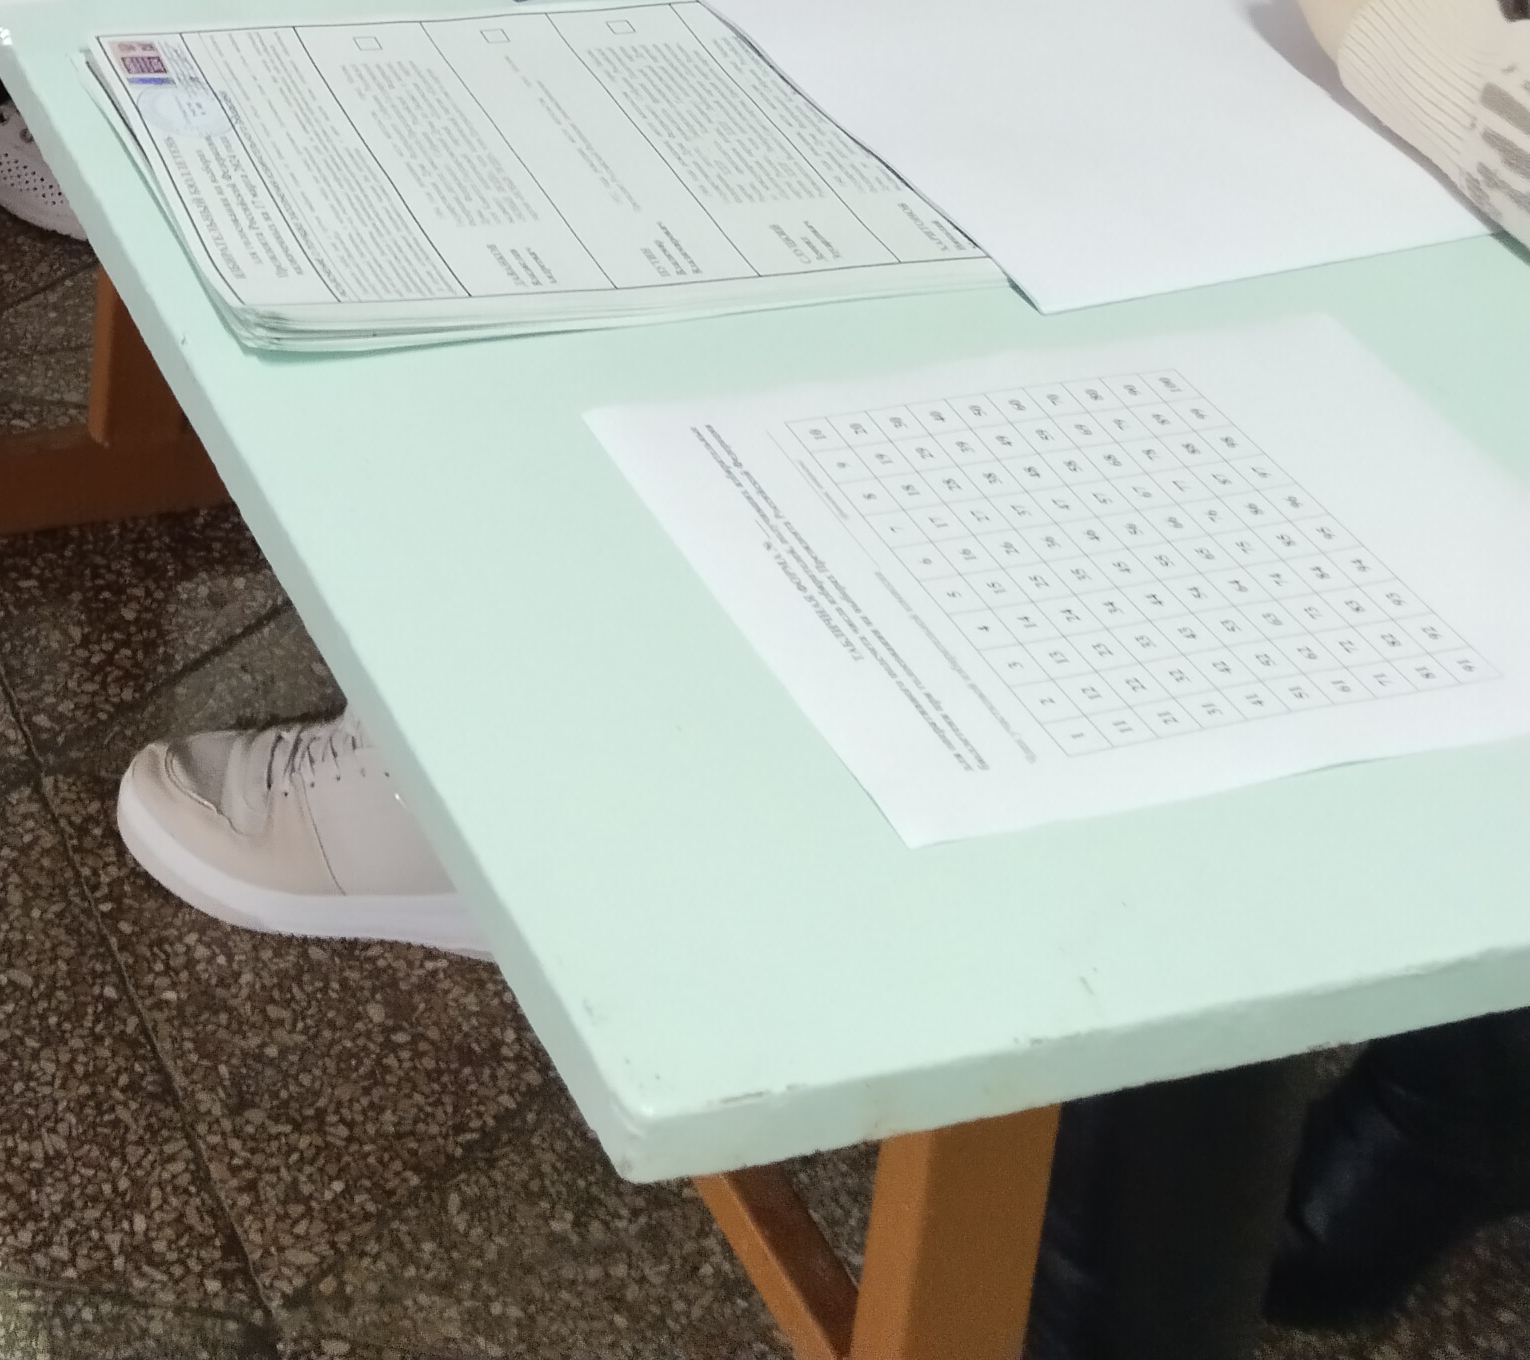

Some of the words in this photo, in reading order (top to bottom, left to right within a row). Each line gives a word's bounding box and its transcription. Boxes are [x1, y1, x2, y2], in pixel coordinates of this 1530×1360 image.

[1035, 428, 1055, 441] 59
[1074, 423, 1093, 436] 69
[954, 440, 975, 454] 39
[995, 435, 1013, 447] 49
[874, 452, 894, 466] 19
[914, 447, 935, 460] 29
[1102, 453, 1123, 467] 68
[1022, 465, 1041, 479] 48
[1062, 459, 1083, 473] 58
[941, 477, 963, 492] 28
[982, 472, 1003, 485] 38
[900, 483, 921, 497] 18
[1131, 485, 1153, 499] 67
[1171, 480, 1187, 493] 77
[1050, 498, 1071, 511] 47
[1091, 492, 1114, 505] 57
[969, 510, 991, 523] 27
[1009, 504, 1032, 517] 37
[1204, 509, 1218, 523] 76
[927, 516, 949, 529] 17
[1124, 522, 1144, 536] 56
[1164, 516, 1184, 529] 66
[1041, 535, 1062, 549] 36
[1083, 529, 1101, 542] 46
[958, 548, 978, 561] 16
[1000, 541, 1021, 556] 26
[1193, 547, 1216, 561] 65
[1234, 540, 1254, 555] 75
[1111, 560, 1132, 574] 45
[1153, 554, 1175, 568] 55
[1027, 574, 1050, 589] 25
[1069, 568, 1093, 582] 35
[1268, 572, 1288, 587] 74
[985, 581, 1007, 595] 15
[1187, 586, 1208, 600] 54
[1227, 579, 1249, 593] 64
[1144, 593, 1165, 607] 44
[1102, 600, 1124, 615] 34
[1303, 606, 1323, 620] 73
[1016, 615, 1038, 629] 14
[1059, 608, 1082, 623] 24
[1261, 612, 1284, 627] 63
[1176, 626, 1198, 640] 43
[1219, 619, 1242, 633] 53
[1134, 634, 1157, 649] 33
[1337, 639, 1357, 654] 72
[1091, 642, 1115, 657] 23
[1296, 645, 1318, 660] 62
[1048, 650, 1070, 665] 13
[1254, 653, 1277, 667] 52
[1211, 660, 1232, 675] 42
[1168, 668, 1191, 683] 32
[1372, 672, 1392, 687] 71
[1124, 677, 1148, 693] 22
[1330, 679, 1352, 693] 61
[1080, 686, 1103, 700] 12
[1288, 685, 1310, 700] 51
[1244, 693, 1265, 707] 41
[1200, 702, 1223, 716] 31
[1156, 710, 1180, 725] 21
[1111, 719, 1134, 734] 11
